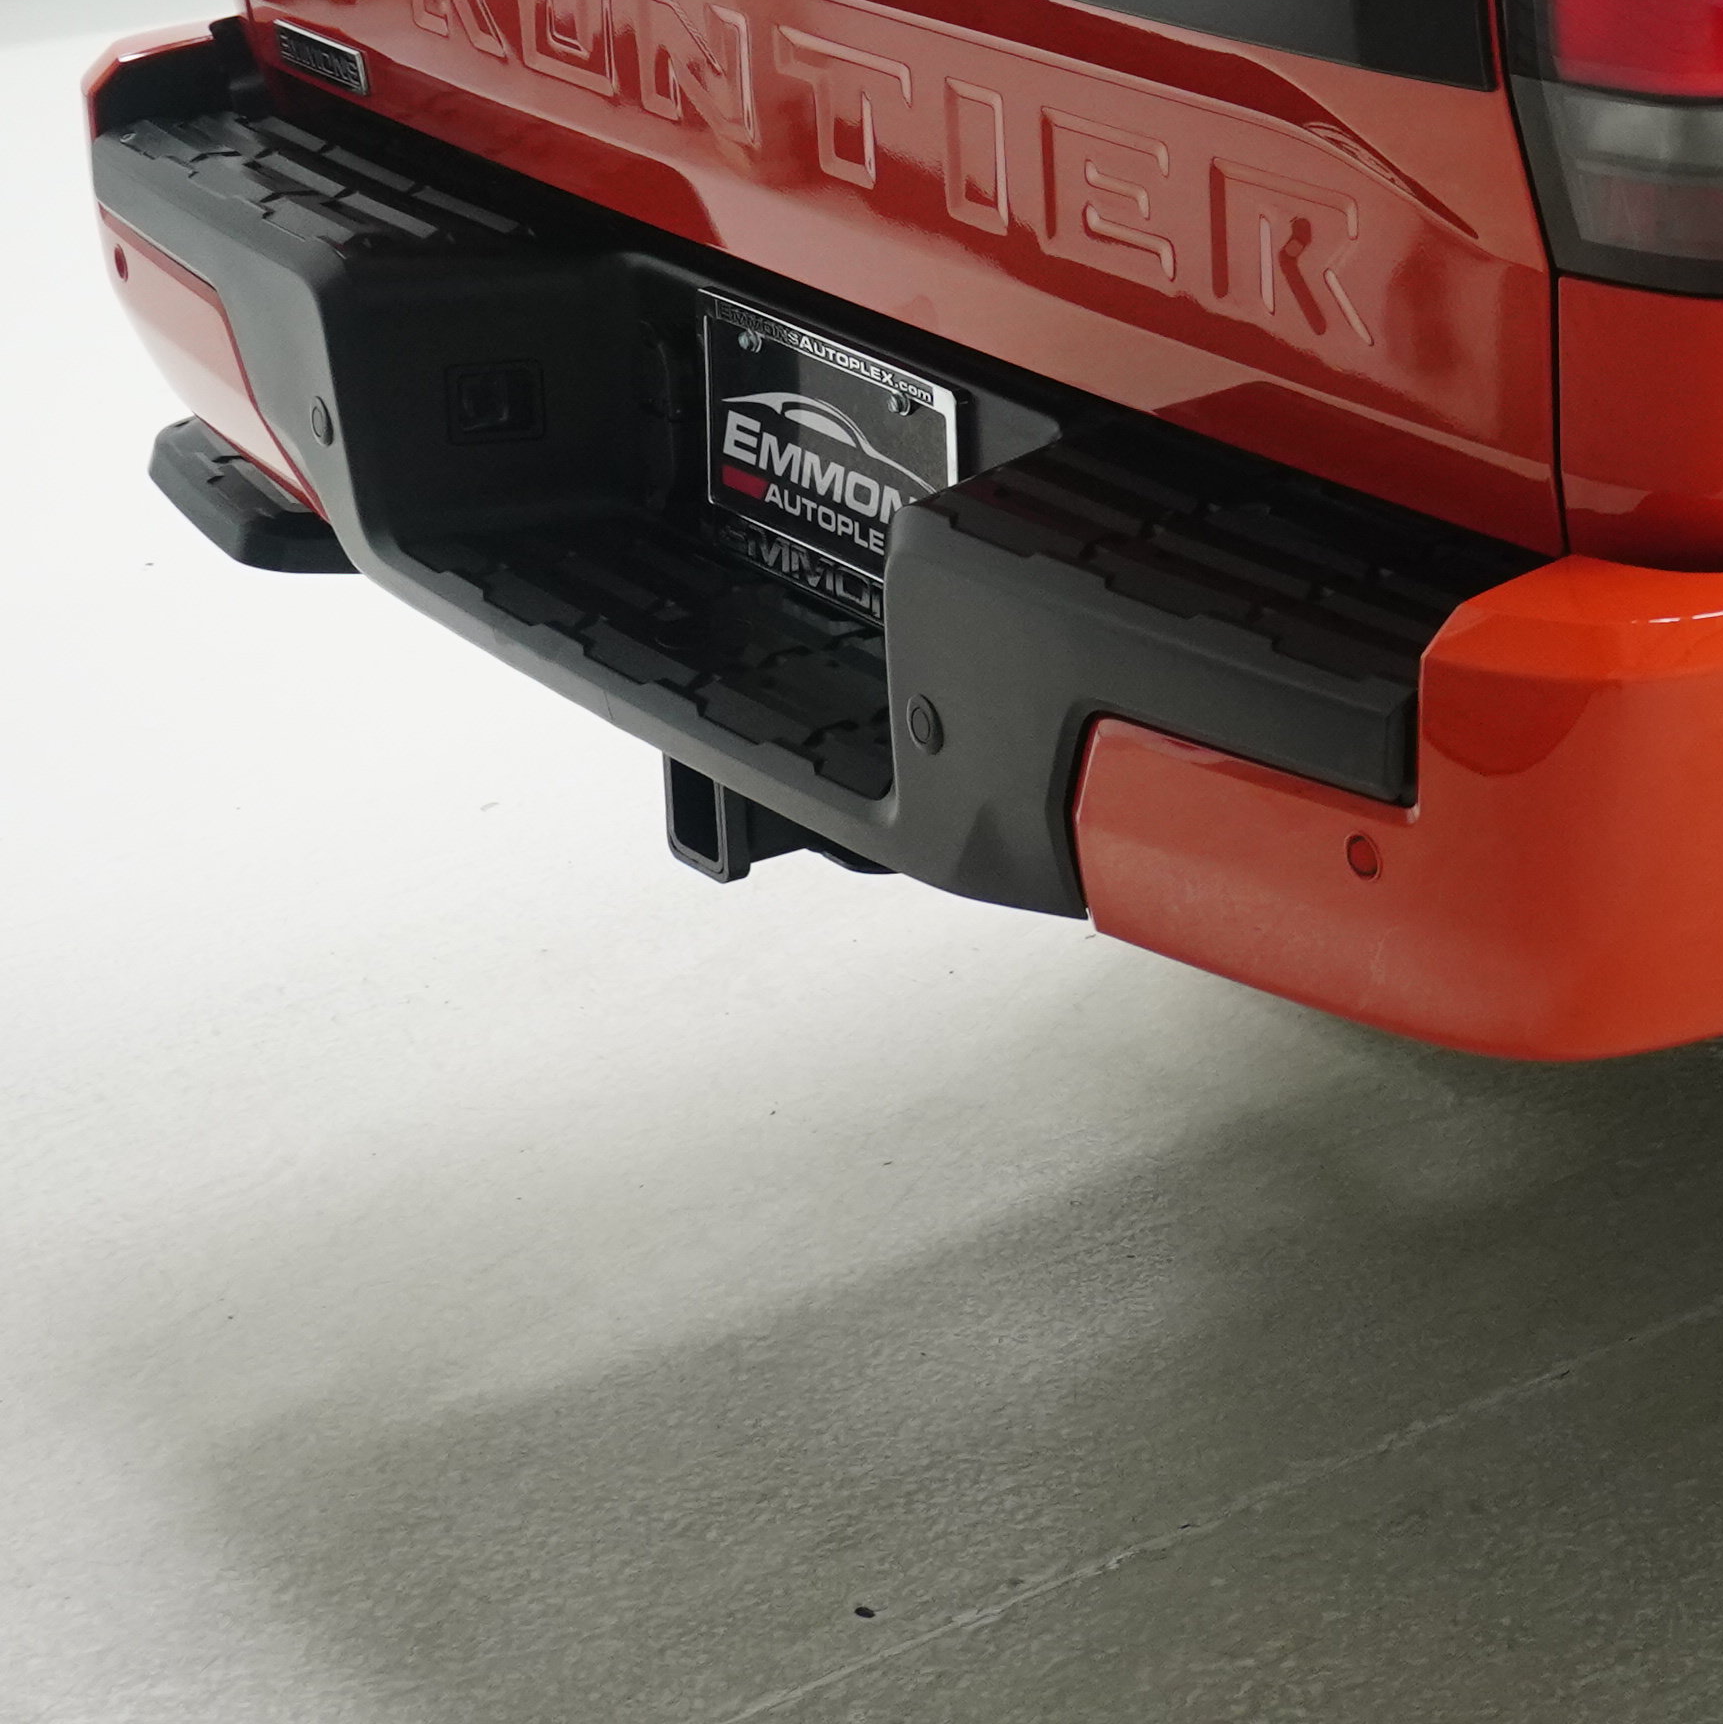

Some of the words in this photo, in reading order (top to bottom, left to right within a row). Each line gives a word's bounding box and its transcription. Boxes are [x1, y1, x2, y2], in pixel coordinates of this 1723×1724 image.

[278, 32, 362, 88] EMMONS
[722, 409, 918, 526] EMMON
[764, 482, 886, 556] AUTOPLE
